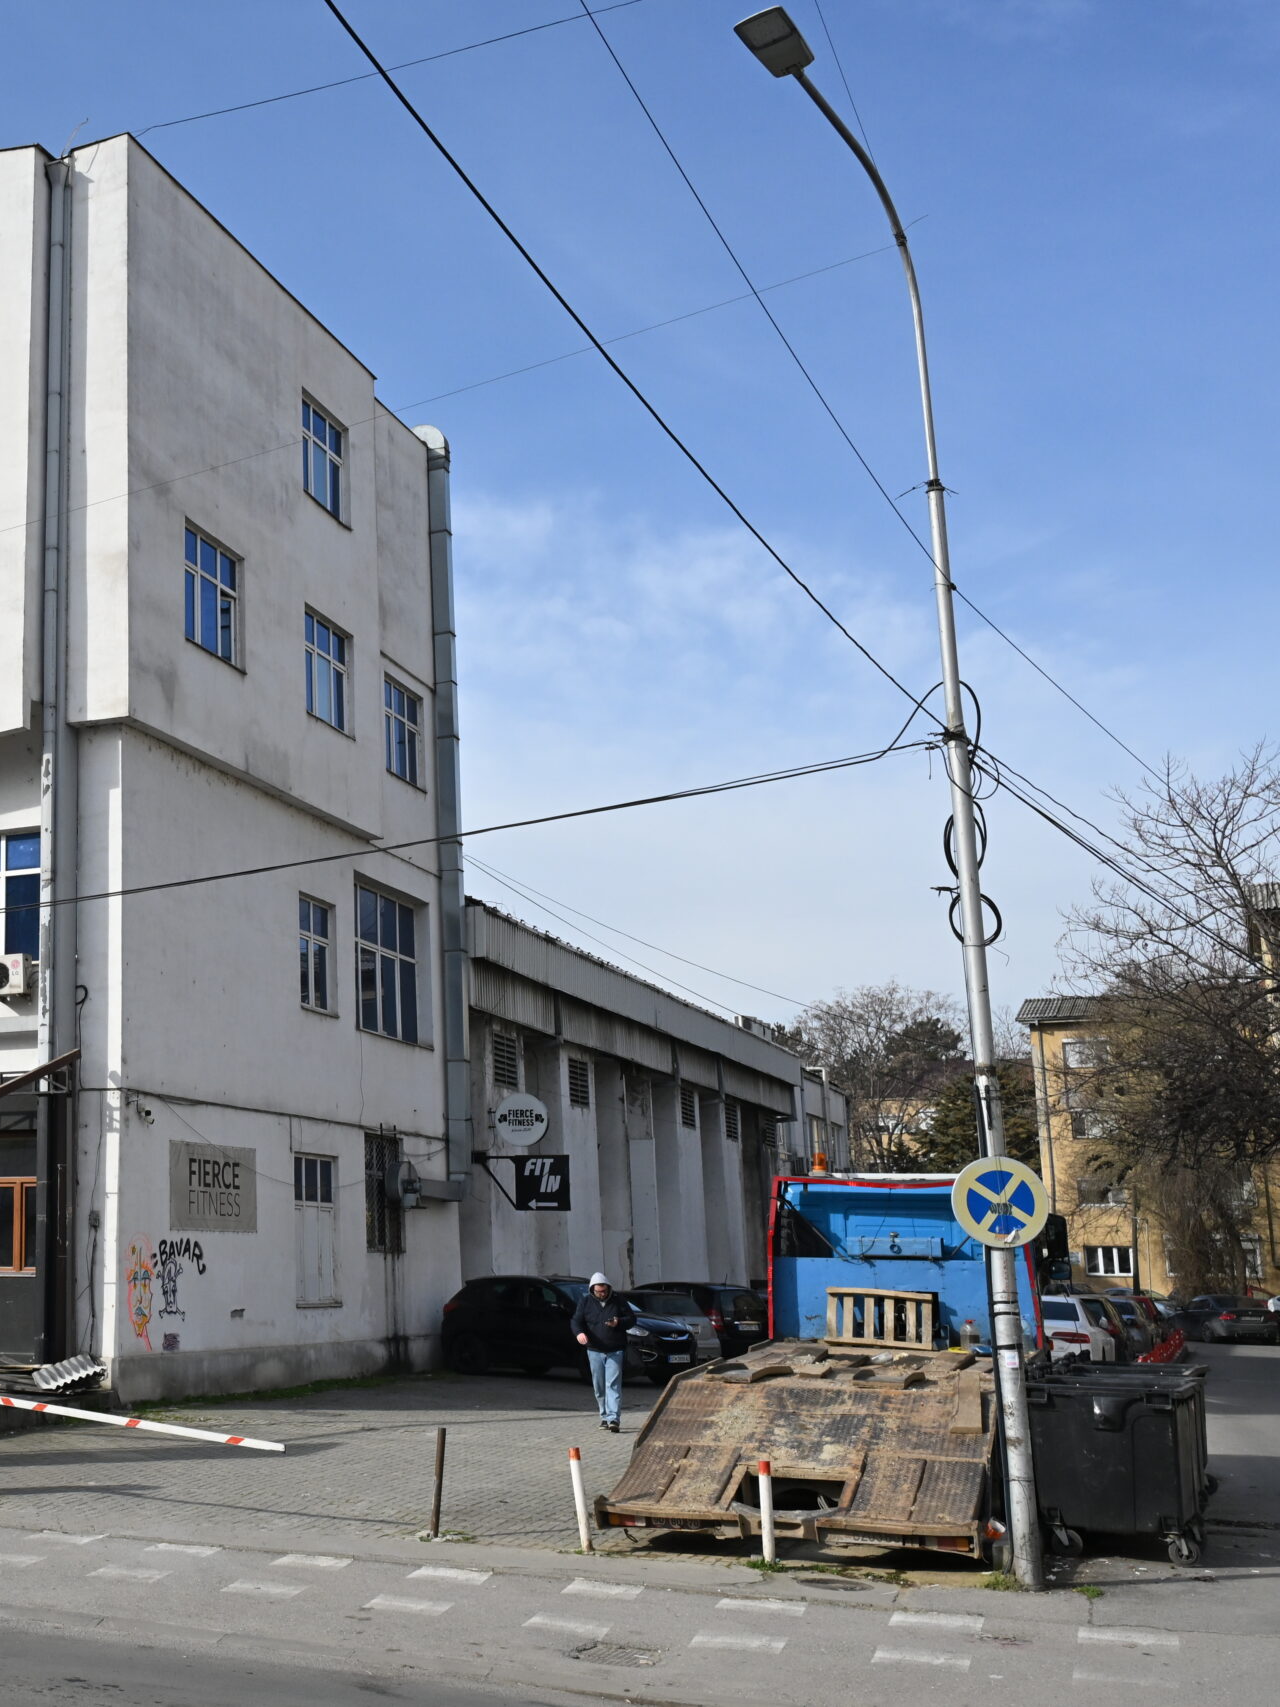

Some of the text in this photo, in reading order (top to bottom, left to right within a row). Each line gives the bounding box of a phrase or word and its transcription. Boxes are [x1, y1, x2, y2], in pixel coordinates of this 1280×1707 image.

[508, 1109, 534, 1118] FIERCE
[508, 1119, 535, 1127] FITNESS
[188, 1158, 241, 1190] FIERCE
[524, 1158, 554, 1176] FIT
[540, 1173, 561, 1193] IN
[188, 1189, 241, 1217] FITNESS
